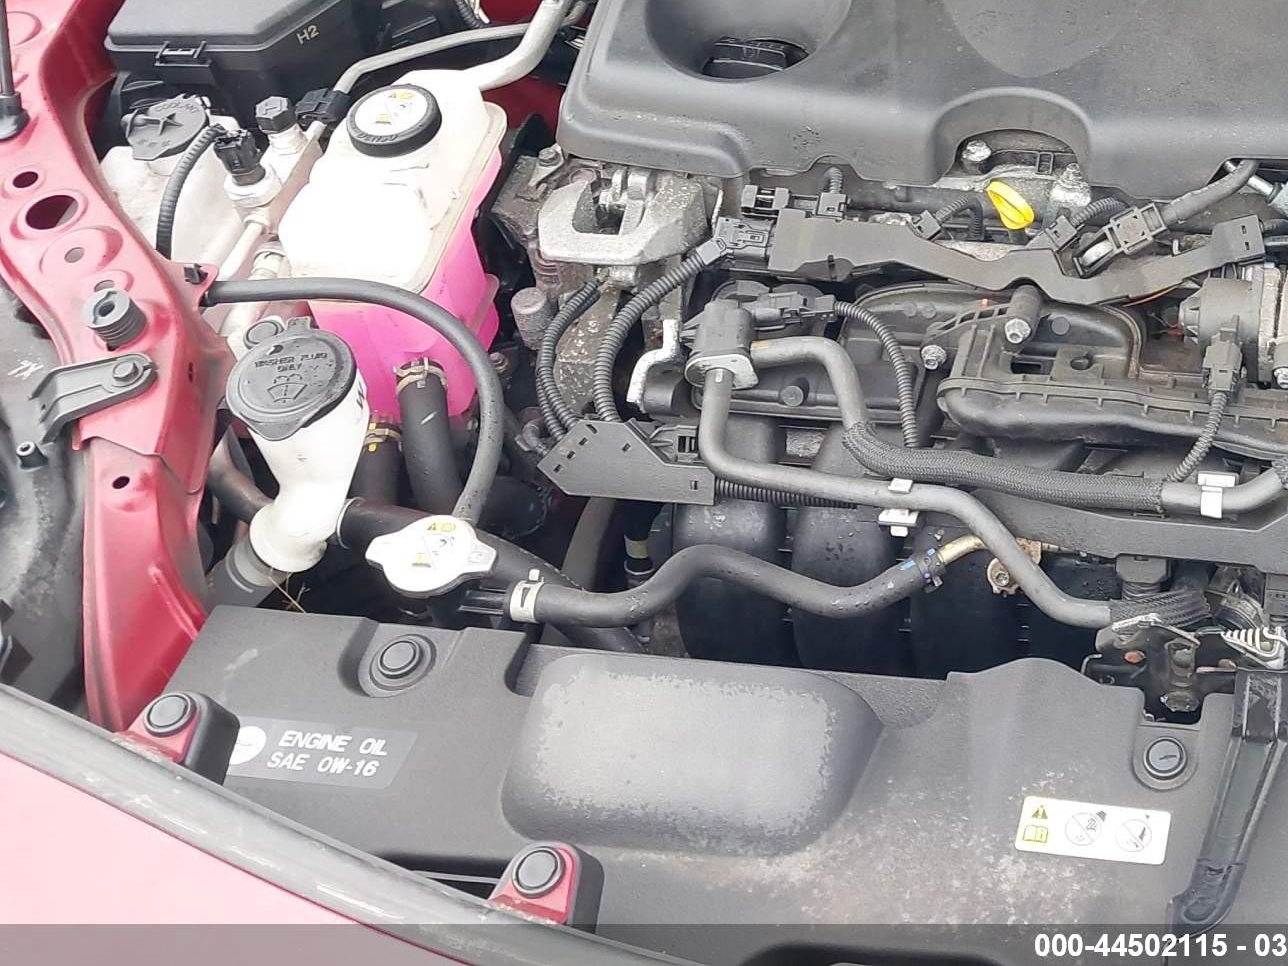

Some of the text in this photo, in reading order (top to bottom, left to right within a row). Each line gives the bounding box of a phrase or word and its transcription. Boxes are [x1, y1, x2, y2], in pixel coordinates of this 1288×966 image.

[295, 25, 320, 45] H2
[254, 355, 295, 368] WASHER
[278, 730, 388, 756] ENGINE OIL
[267, 751, 380, 777] SAE 0W-16
